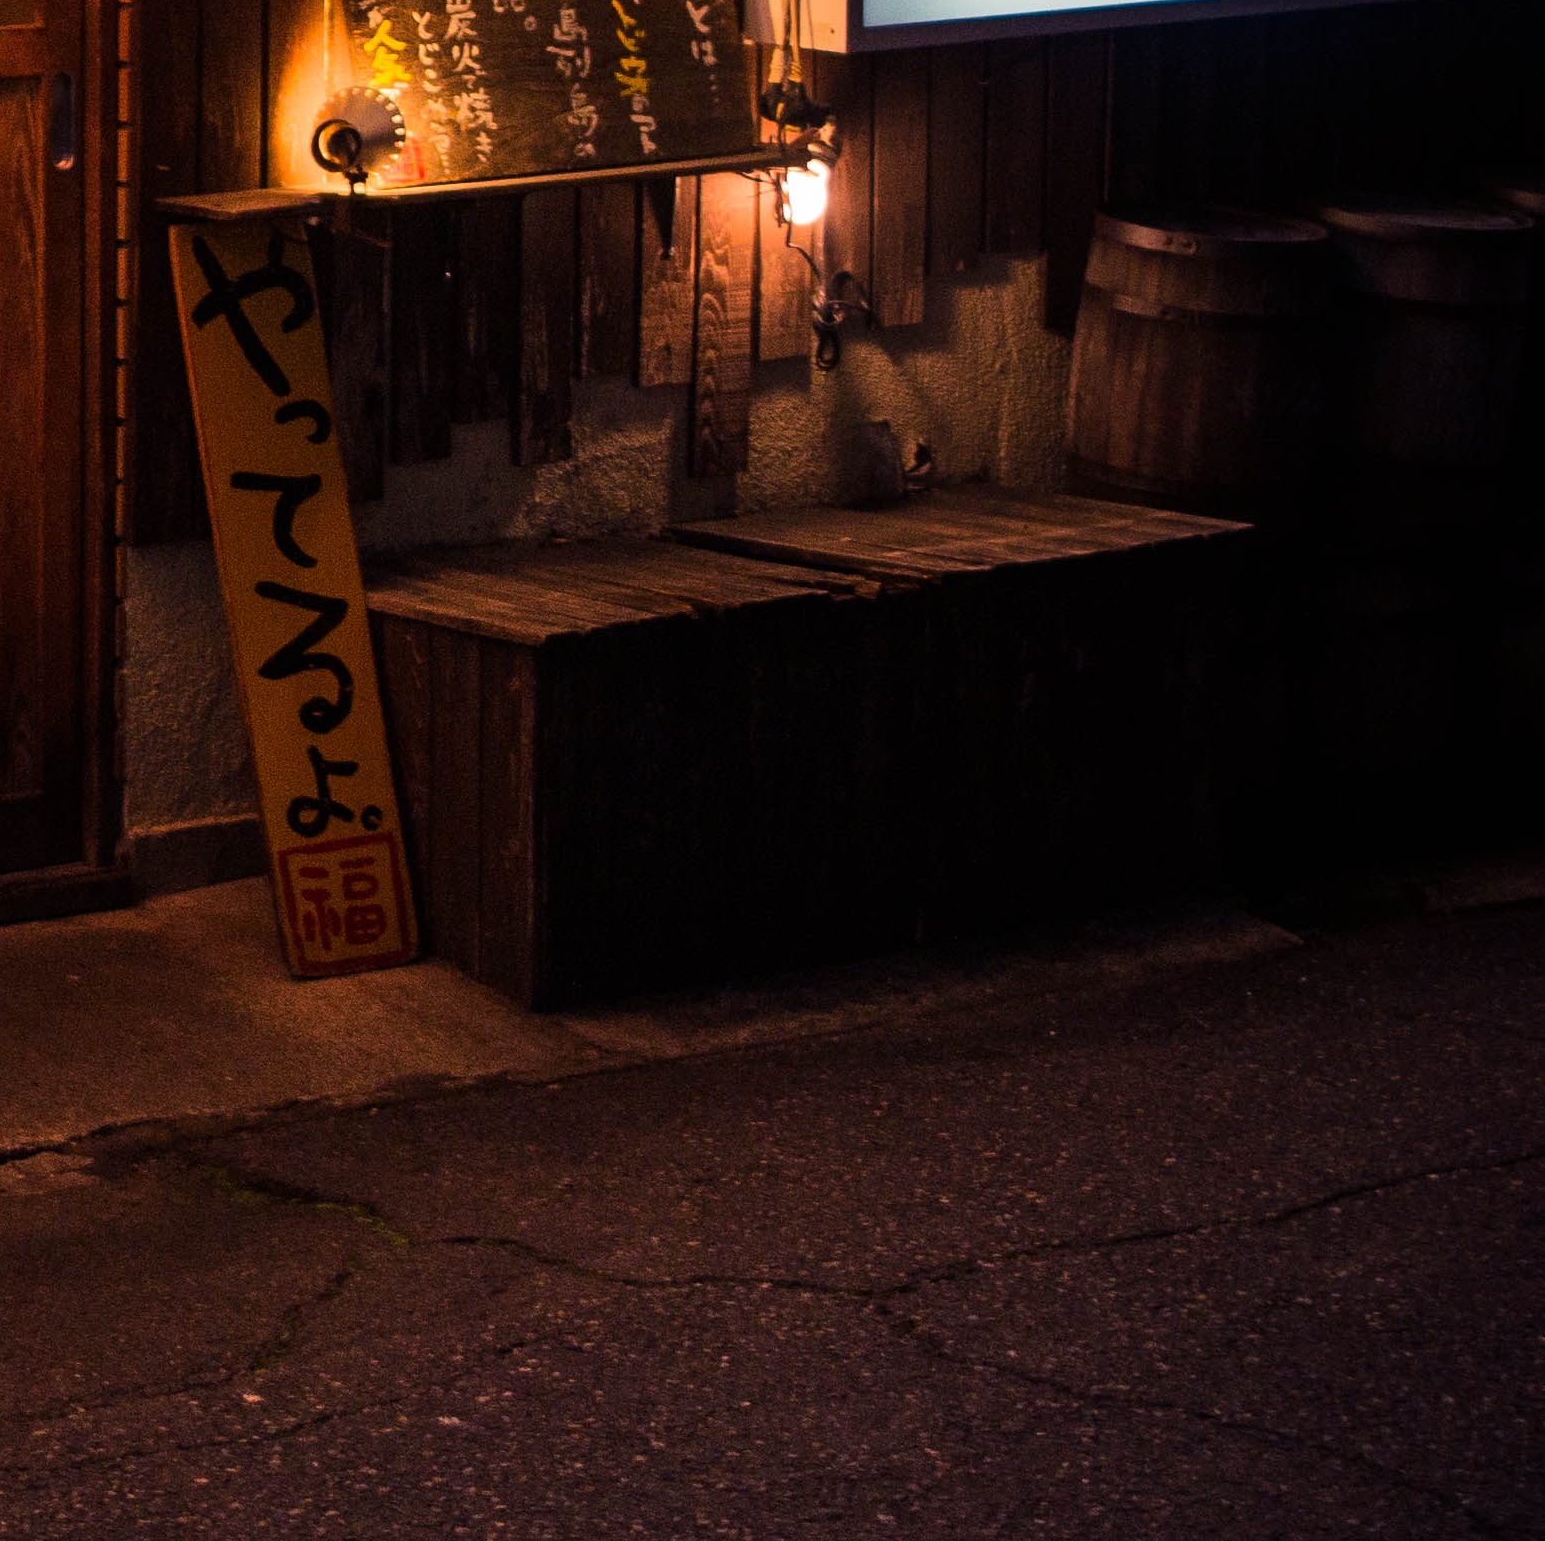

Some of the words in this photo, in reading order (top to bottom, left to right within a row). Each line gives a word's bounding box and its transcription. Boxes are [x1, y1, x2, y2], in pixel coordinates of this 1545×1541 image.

[191, 232, 383, 838] やってるよ。
[299, 858, 389, 950] 福
